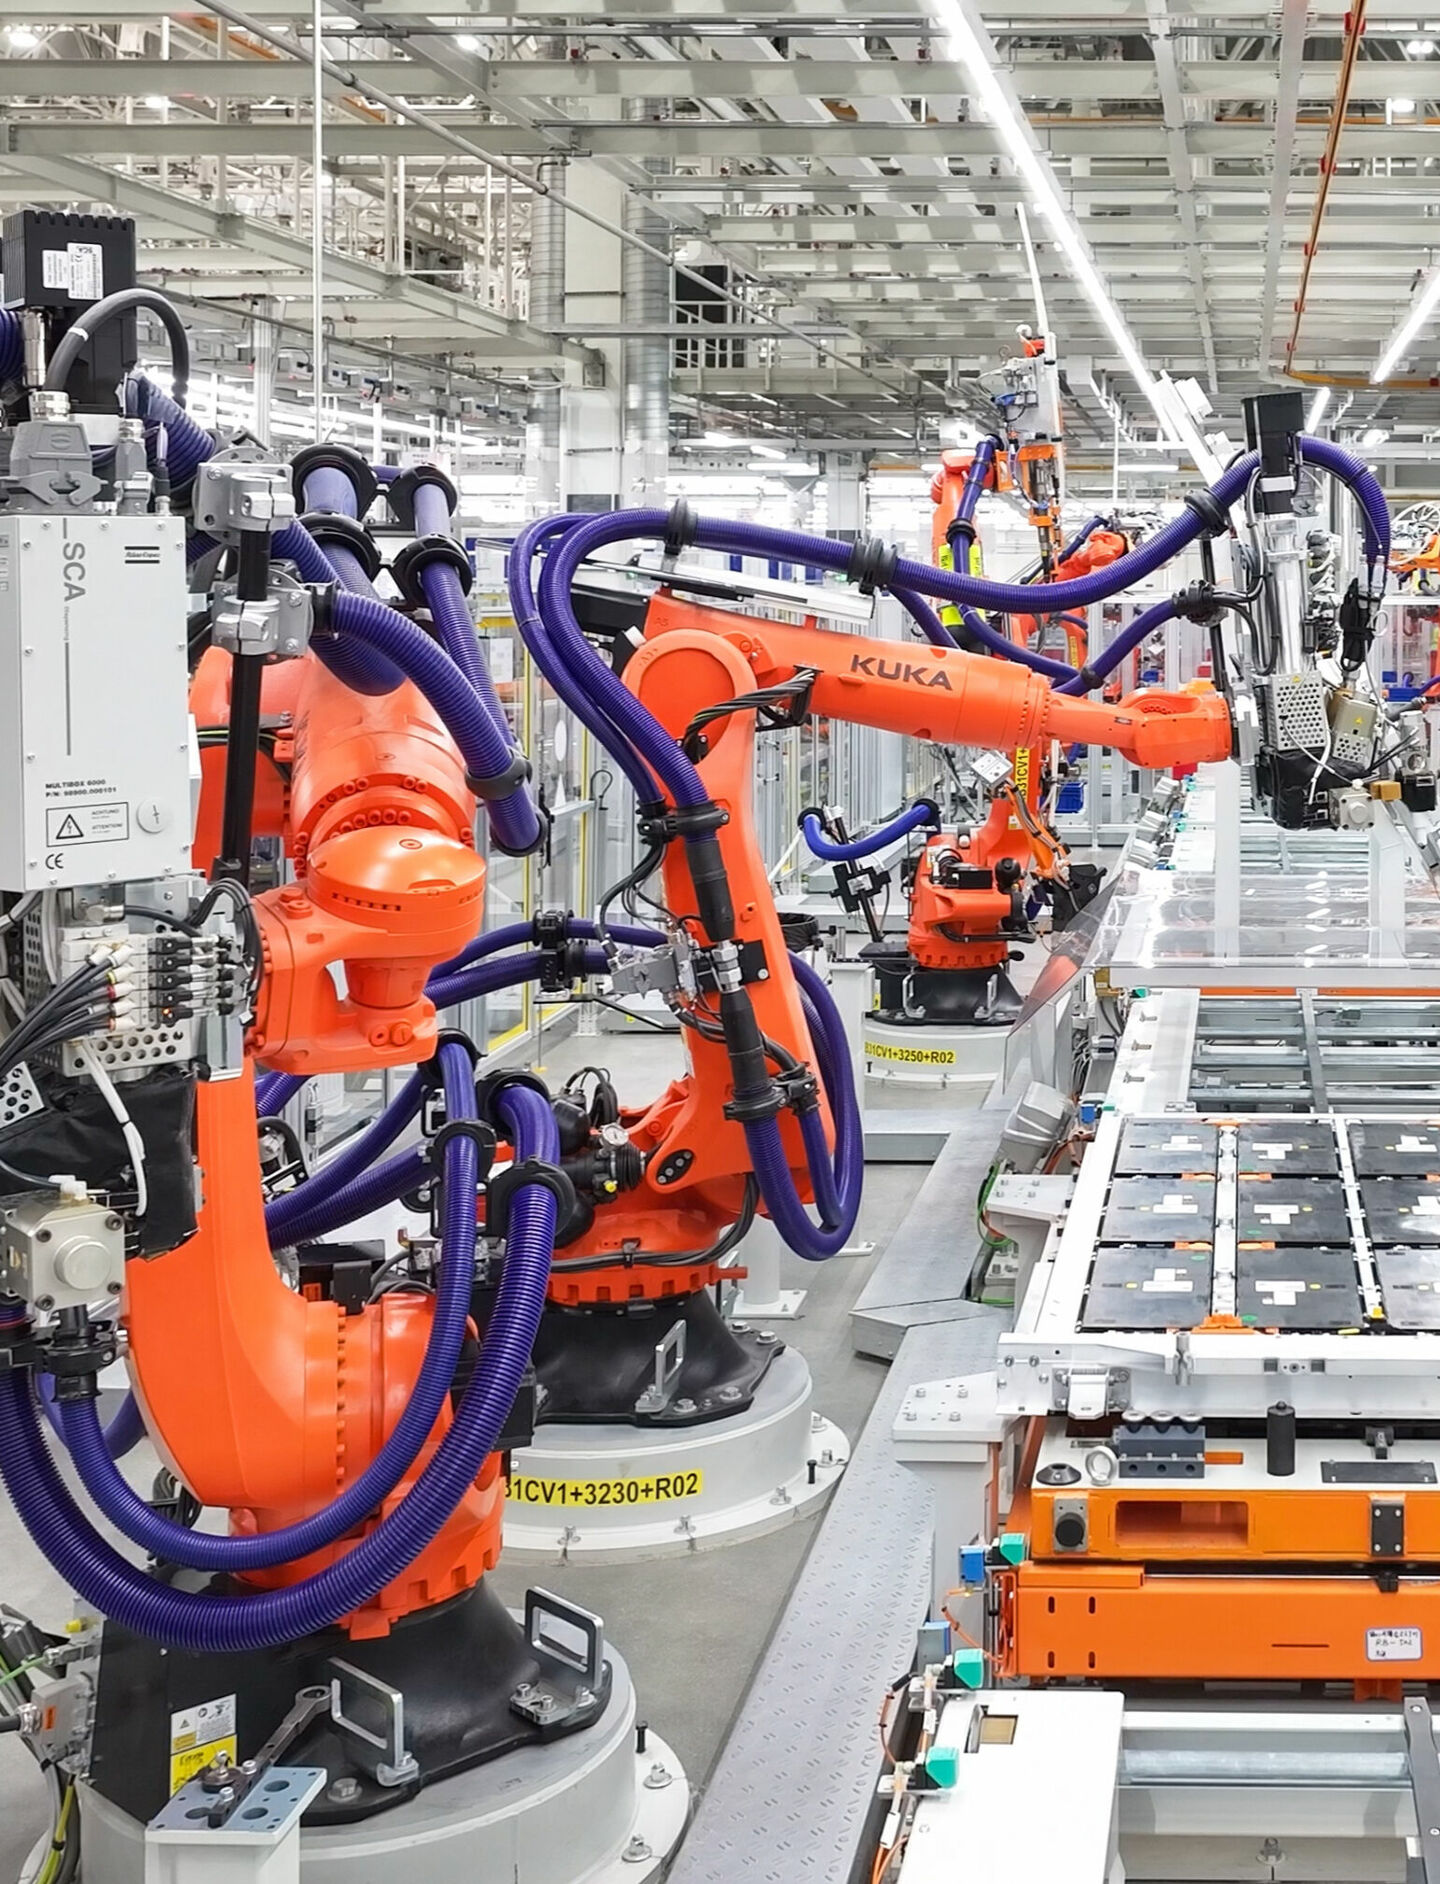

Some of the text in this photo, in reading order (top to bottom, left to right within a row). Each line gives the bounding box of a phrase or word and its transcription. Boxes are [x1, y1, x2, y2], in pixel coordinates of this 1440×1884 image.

[63, 542, 86, 602] SCA
[851, 654, 953, 691] KUKA
[45, 780, 85, 789] MULTIBOX
[45, 852, 64, 870] CE
